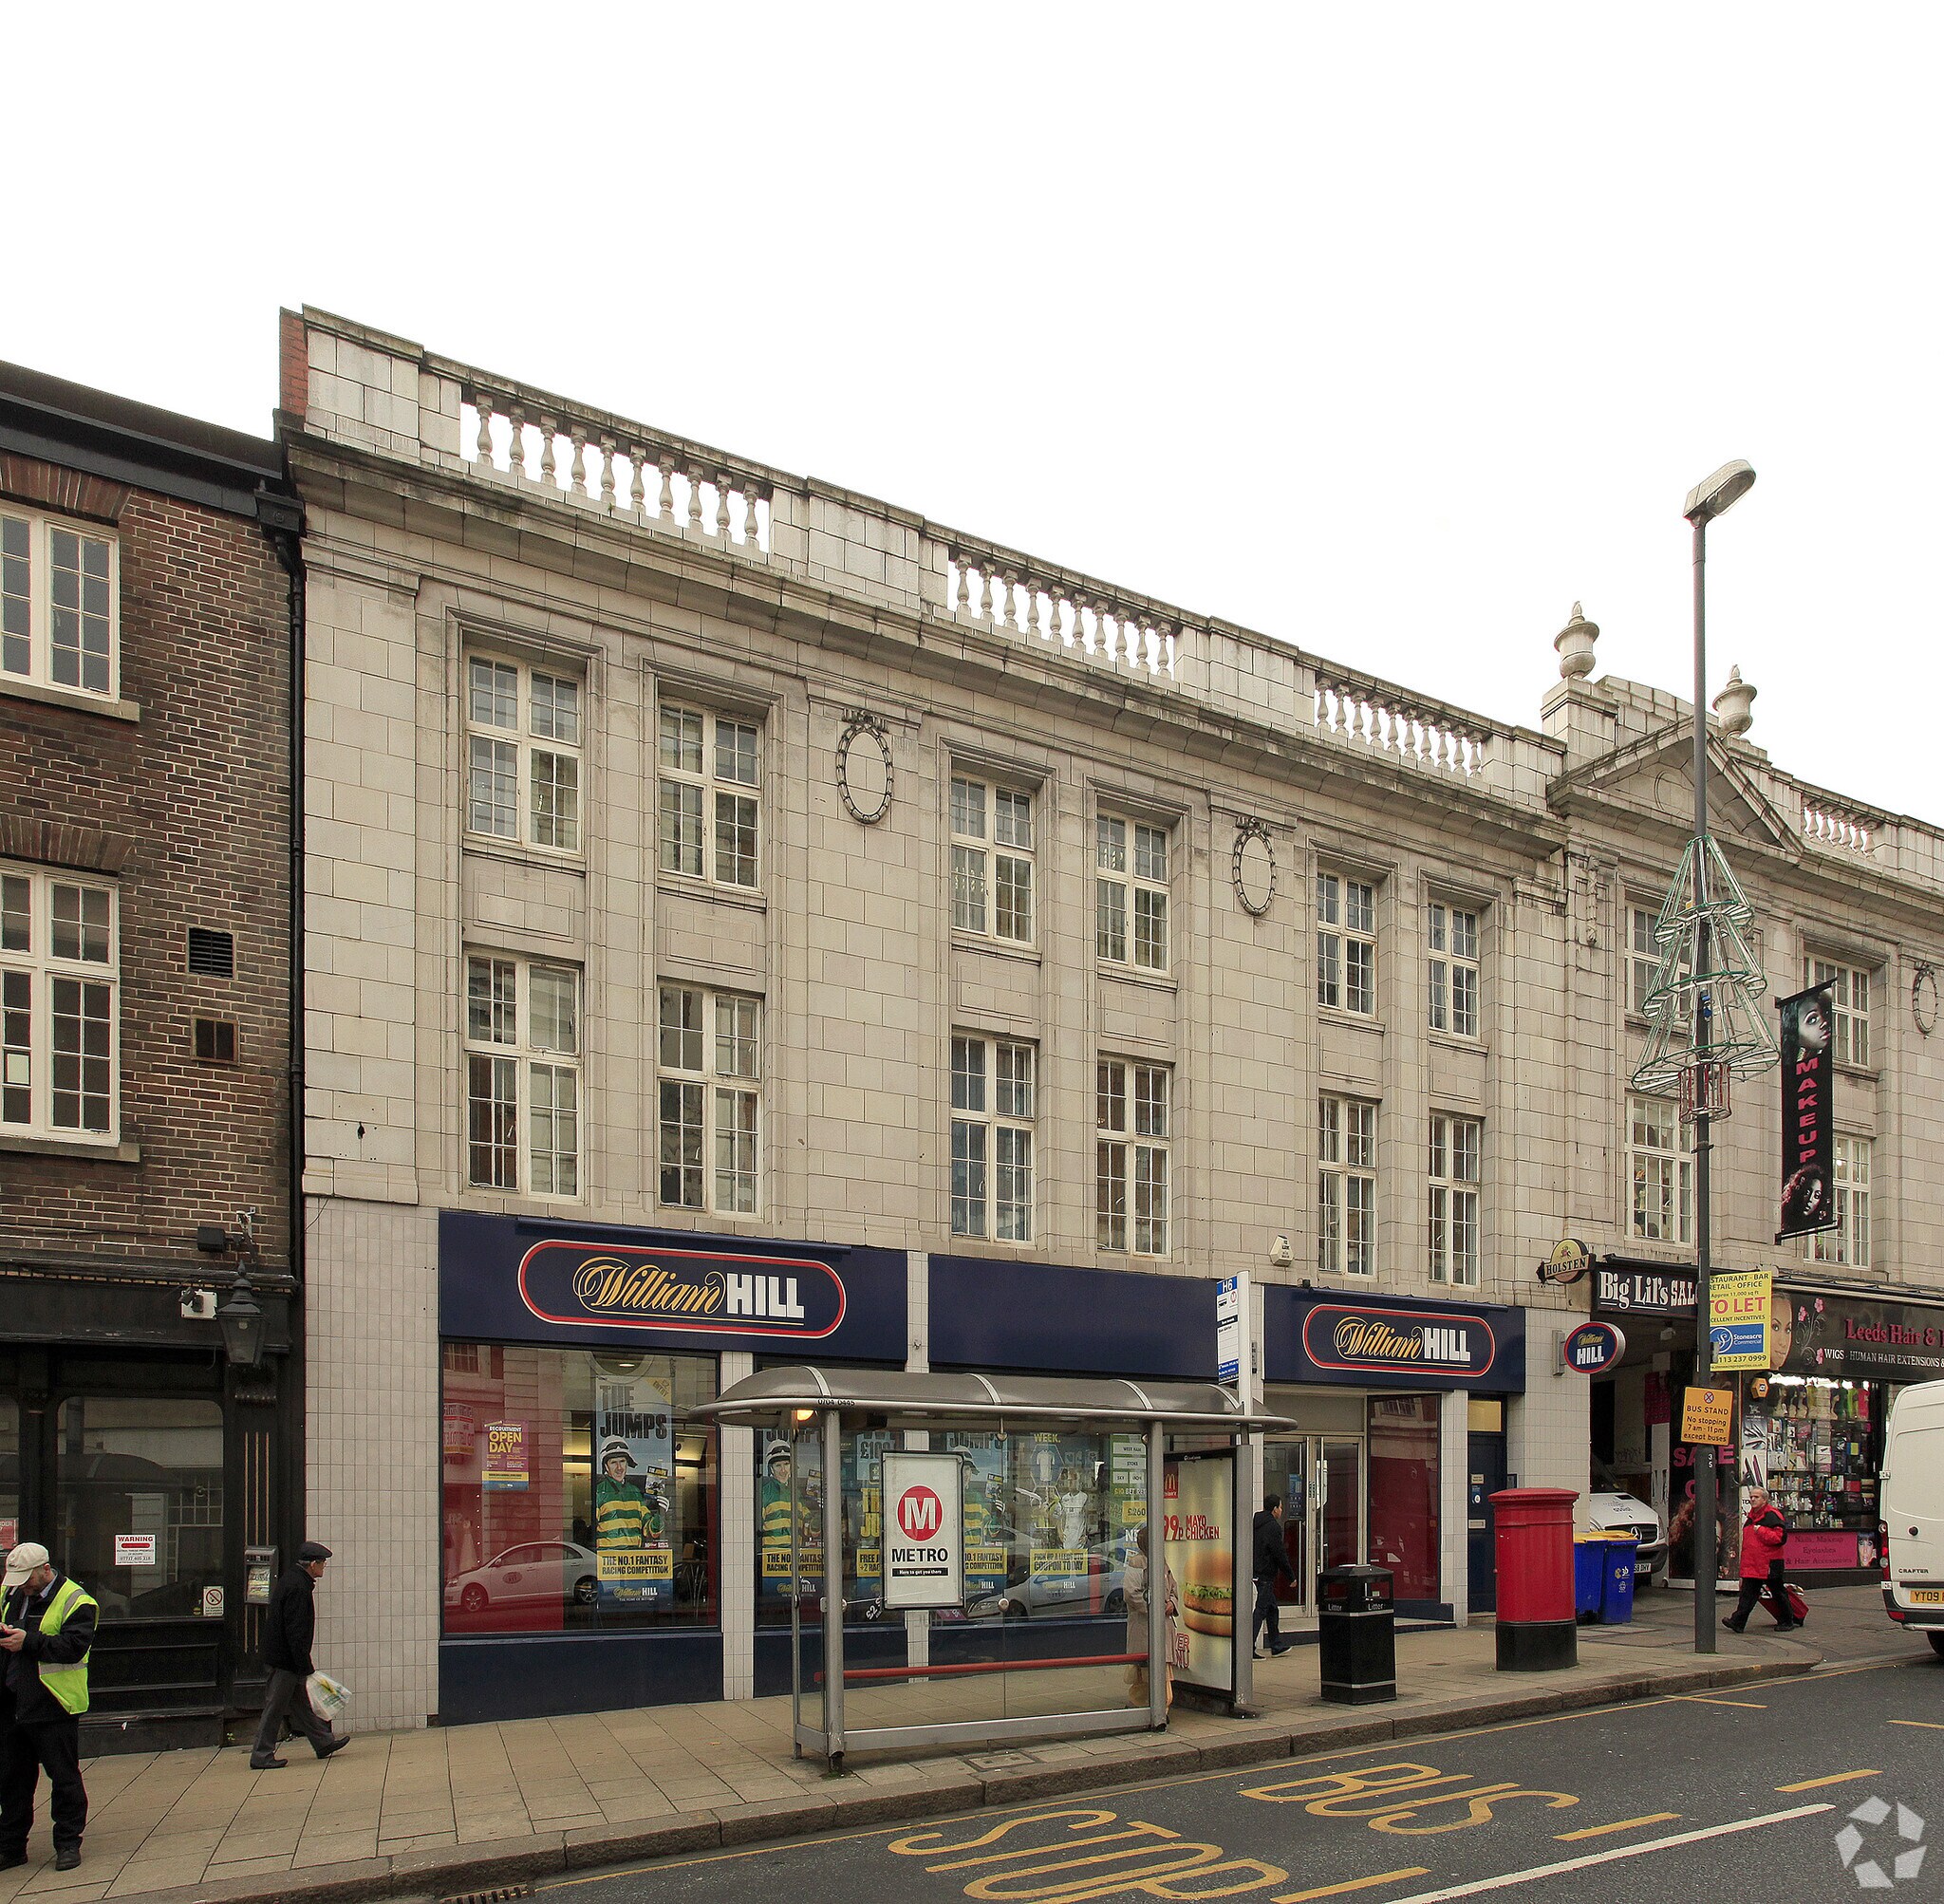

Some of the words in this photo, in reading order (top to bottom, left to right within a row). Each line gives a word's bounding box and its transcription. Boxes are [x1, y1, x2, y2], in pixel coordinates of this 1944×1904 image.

[1795, 1057, 1819, 1164] MAKEUP
[1546, 1258, 1586, 1276] HOLSTEN
[573, 1257, 726, 1315] William
[727, 1273, 805, 1318] HILL
[1222, 1279, 1233, 1294] H6
[1599, 1271, 1630, 1309] Big
[1635, 1275, 1669, 1306] Lil's
[1734, 1297, 1766, 1313] LET
[1845, 1318, 1887, 1343] Leeds
[1888, 1323, 1922, 1346] Hair
[1923, 1327, 1936, 1347] &
[1334, 1316, 1424, 1359] William
[1424, 1327, 1471, 1362] HILL
[1576, 1345, 1605, 1366] HILL
[1824, 1348, 1844, 1360] WIGS
[1849, 1350, 1877, 1362] HUMAN
[1878, 1353, 1897, 1364] HAIR
[1897, 1354, 1940, 1368] EXTENSIONS
[600, 1385, 635, 1411] THE
[1687, 1405, 1702, 1413] BUS
[1704, 1406, 1729, 1416] STAND
[600, 1412, 668, 1439] JUMPS
[1687, 1415, 1696, 1424] No
[1698, 1417, 1727, 1427] stopping
[489, 1431, 522, 1443] OPEN
[1034, 1433, 1061, 1444] WEEK.
[1683, 1431, 1706, 1441] except
[1708, 1433, 1728, 1443] buses
[489, 1442, 514, 1453] DAY
[904, 1497, 937, 1530] M
[1186, 1515, 1206, 1528] MAYO
[1186, 1526, 1220, 1540] CHICKEN
[891, 1548, 948, 1562] METRO
[977, 1552, 1003, 1562] FANTASY
[1034, 1553, 1048, 1561] PICK
[1803, 1546, 1837, 1556] Eyelashes
[602, 1556, 617, 1566] THE
[617, 1556, 634, 1566] NO.1
[635, 1555, 668, 1565] FANTASY
[766, 1554, 777, 1563] THE
[859, 1554, 874, 1563] FREE
[1812, 1557, 1853, 1565] Accessories
[602, 1566, 626, 1575] RACING
[626, 1565, 669, 1575] COMPETITION
[766, 1563, 788, 1572] RACING
[969, 1561, 1003, 1571] COMPETITION
[1034, 1560, 1061, 1572] COUPON
[1062, 1560, 1084, 1572] TODAY
[801, 1583, 816, 1593] HILL
[981, 1580, 995, 1590] HILL
[1063, 1580, 1076, 1589] HILL
[642, 1586, 658, 1596] HILL
[1914, 1591, 1939, 1602] YT09
[1328, 1603, 1342, 1612] Litter
[1368, 1602, 1384, 1611] Litter
[1238, 1763, 1580, 1835] BUS
[887, 1810, 1289, 1904] STOP
